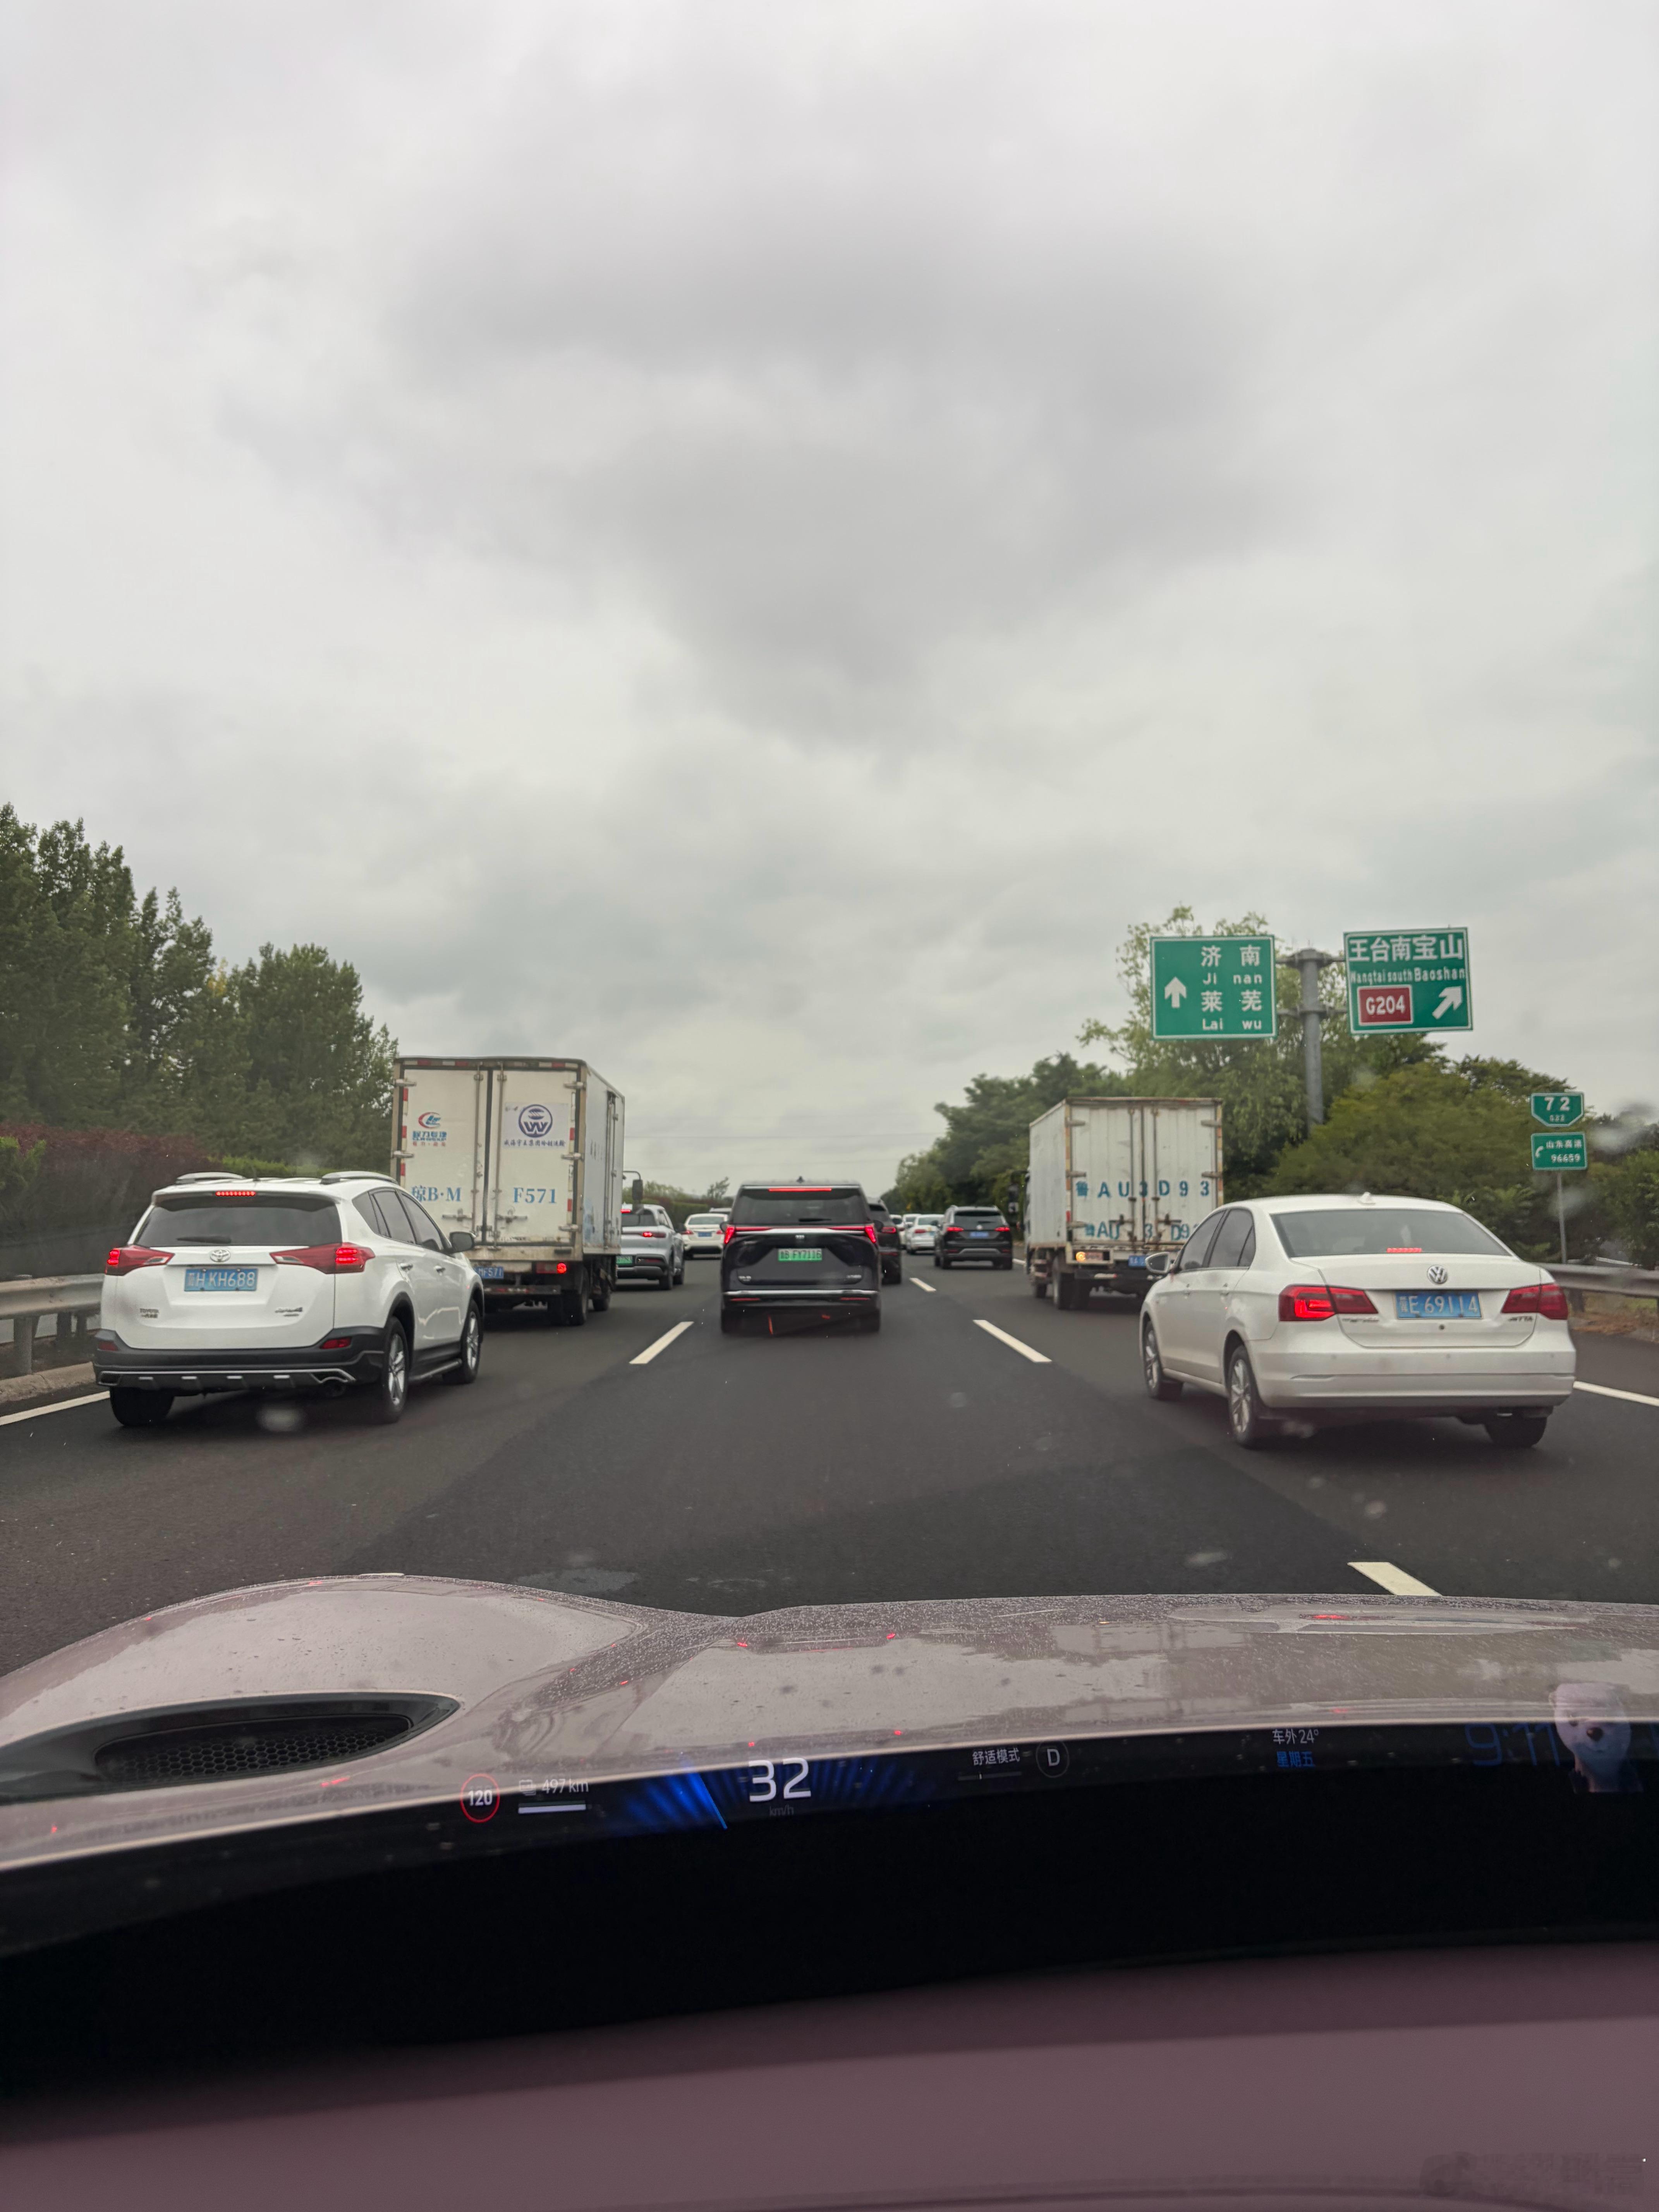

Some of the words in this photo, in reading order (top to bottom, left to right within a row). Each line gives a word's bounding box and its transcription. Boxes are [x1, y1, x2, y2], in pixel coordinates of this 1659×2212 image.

[1201, 944, 1261, 967] 济南
[1349, 934, 1463, 963] 王台南宝山
[1203, 972, 1217, 985] Ji
[1233, 974, 1262, 984] nan
[1414, 966, 1465, 982] Baoshan
[1201, 989, 1262, 1013] 莱芜
[1366, 995, 1405, 1015] G204
[1202, 1018, 1223, 1030] Lai
[1242, 1020, 1262, 1030] wu
[1544, 1097, 1570, 1111] 72
[514, 1187, 557, 1203] F571
[1272, 1728, 1297, 1744] 车外
[972, 1747, 1020, 1766] 舒适模式
[1047, 1748, 1060, 1766] D
[1276, 1750, 1316, 1767] 星期五
[542, 1779, 566, 1794] 497
[568, 1778, 589, 1793] km
[748, 1757, 811, 1802] 32
[468, 1789, 493, 1806] 120
[769, 1804, 795, 1817] km/h
